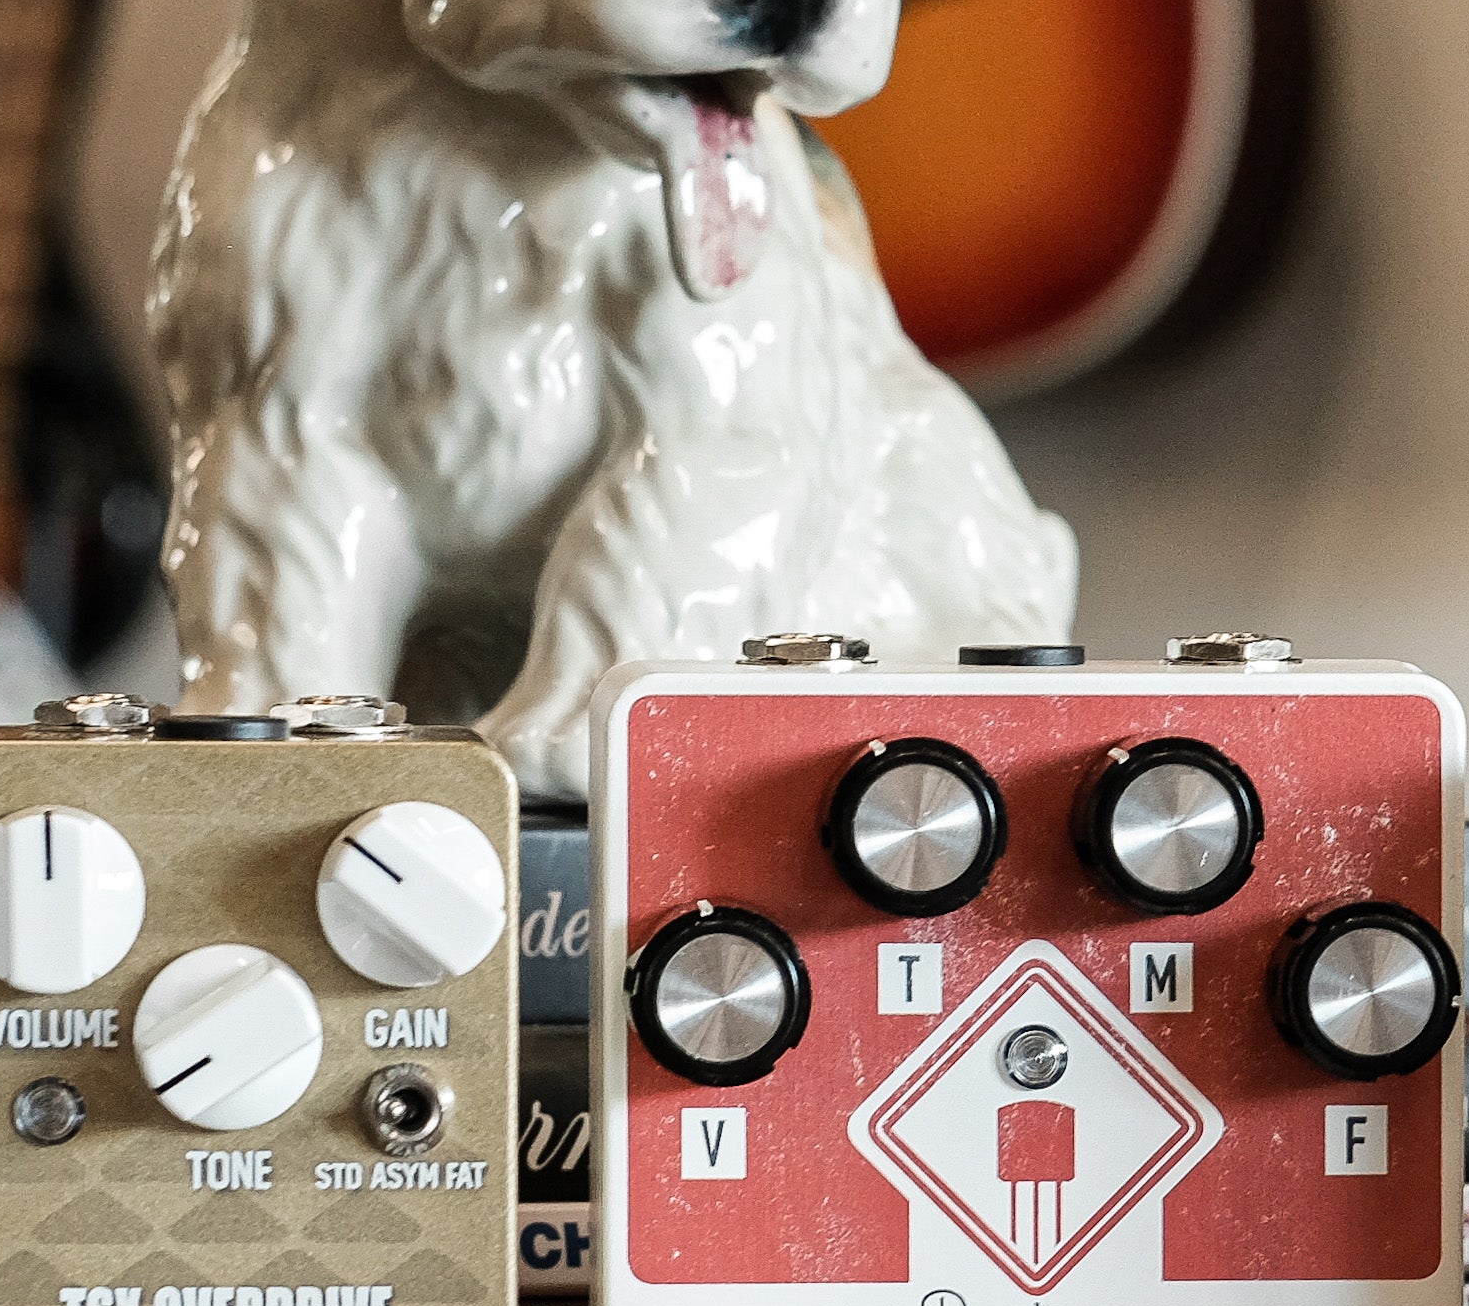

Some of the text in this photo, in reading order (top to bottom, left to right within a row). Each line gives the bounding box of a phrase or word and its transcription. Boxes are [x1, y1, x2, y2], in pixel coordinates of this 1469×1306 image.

[898, 954, 921, 1002] T
[1145, 953, 1178, 1002] M
[364, 1006, 448, 1050] GAIN
[701, 1120, 725, 1168] V
[1345, 1117, 1367, 1164] F
[186, 1150, 273, 1192] TONE
[315, 1159, 487, 1192] STD ASYM FAT
